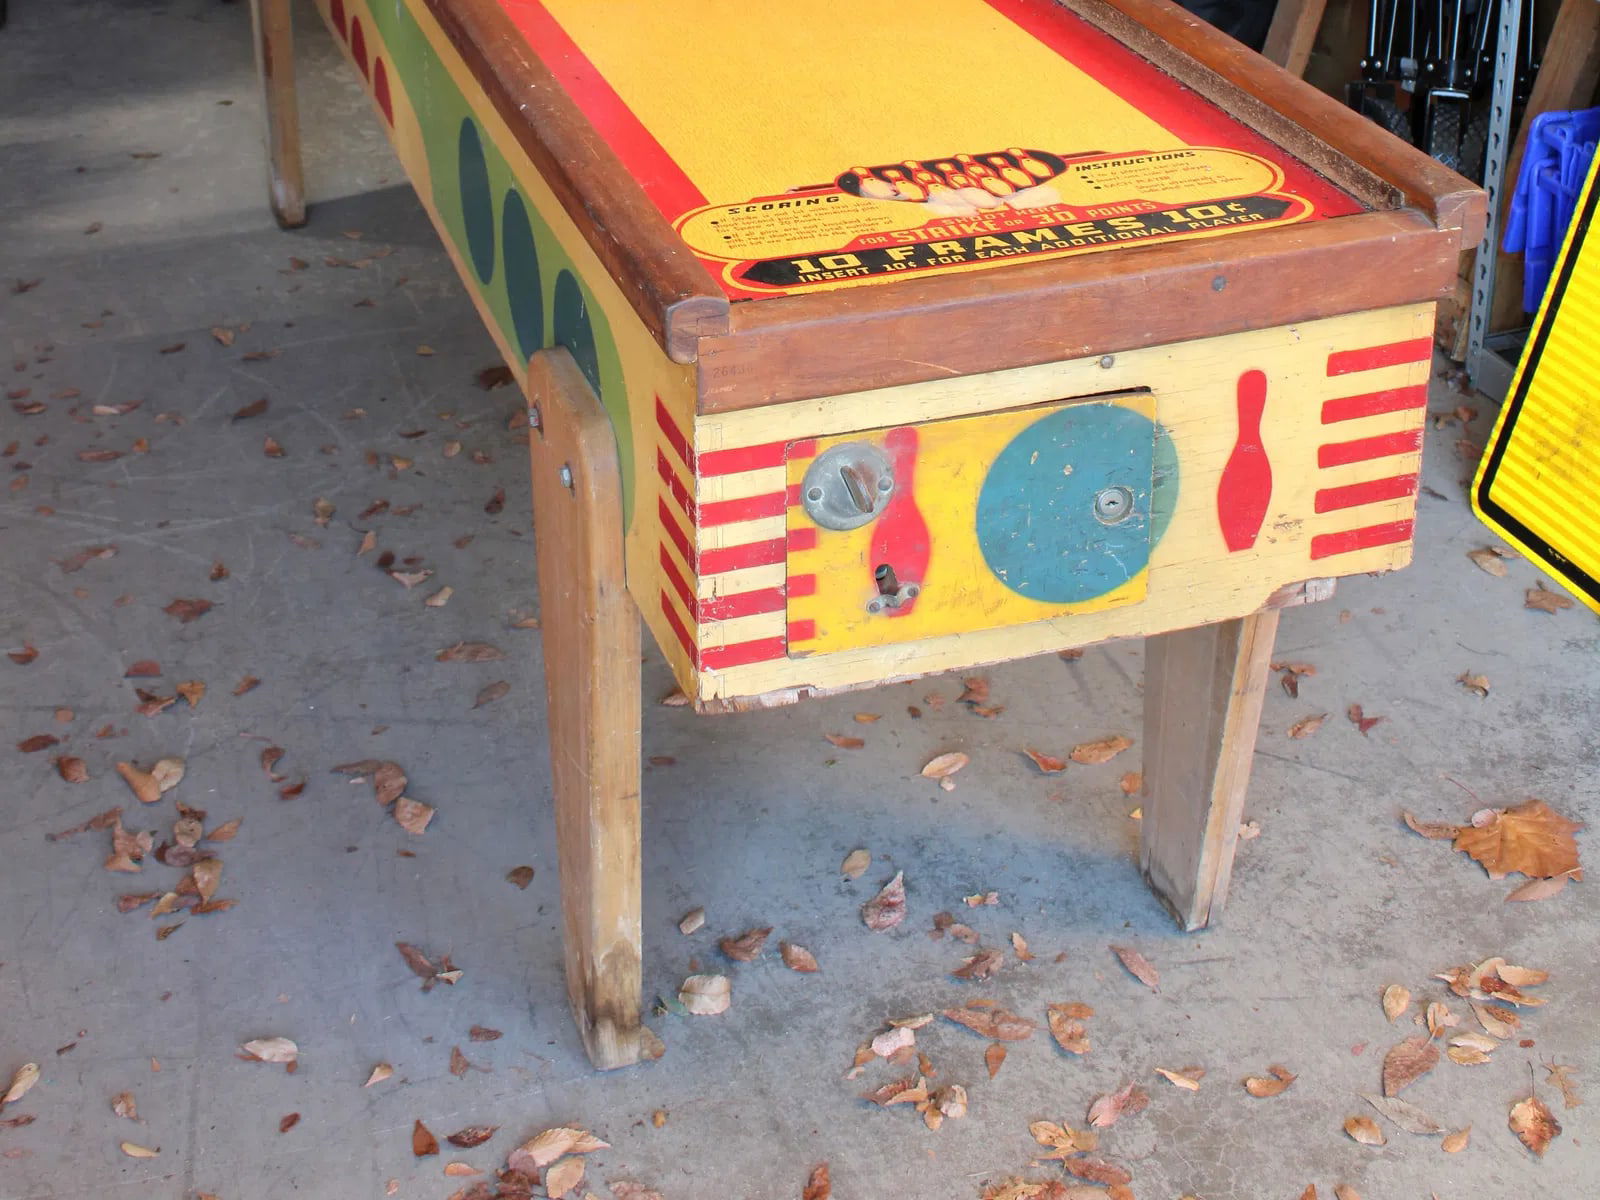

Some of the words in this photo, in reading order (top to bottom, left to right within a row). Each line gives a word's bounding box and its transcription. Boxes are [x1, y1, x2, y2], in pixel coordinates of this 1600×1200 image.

[1075, 151, 1197, 172] INSTRUCTIONS
[728, 196, 840, 215] SCORING
[942, 212, 1007, 226] SHOOT
[1016, 205, 1061, 216] HERE
[790, 252, 863, 274] 10
[885, 216, 1146, 261] FRAMES
[1161, 201, 1248, 224] 10¢
[859, 236, 888, 246] FOR
[890, 221, 997, 243] STRIKE
[1003, 217, 1025, 228] OR
[1031, 210, 1078, 225] 30
[1086, 201, 1158, 219] POINTS
[797, 266, 870, 283] INSERT
[926, 254, 966, 267] FOR
[974, 245, 1030, 260] EACH
[1040, 225, 1177, 252] ADDITIONAL
[1190, 212, 1265, 230] PLAYER
